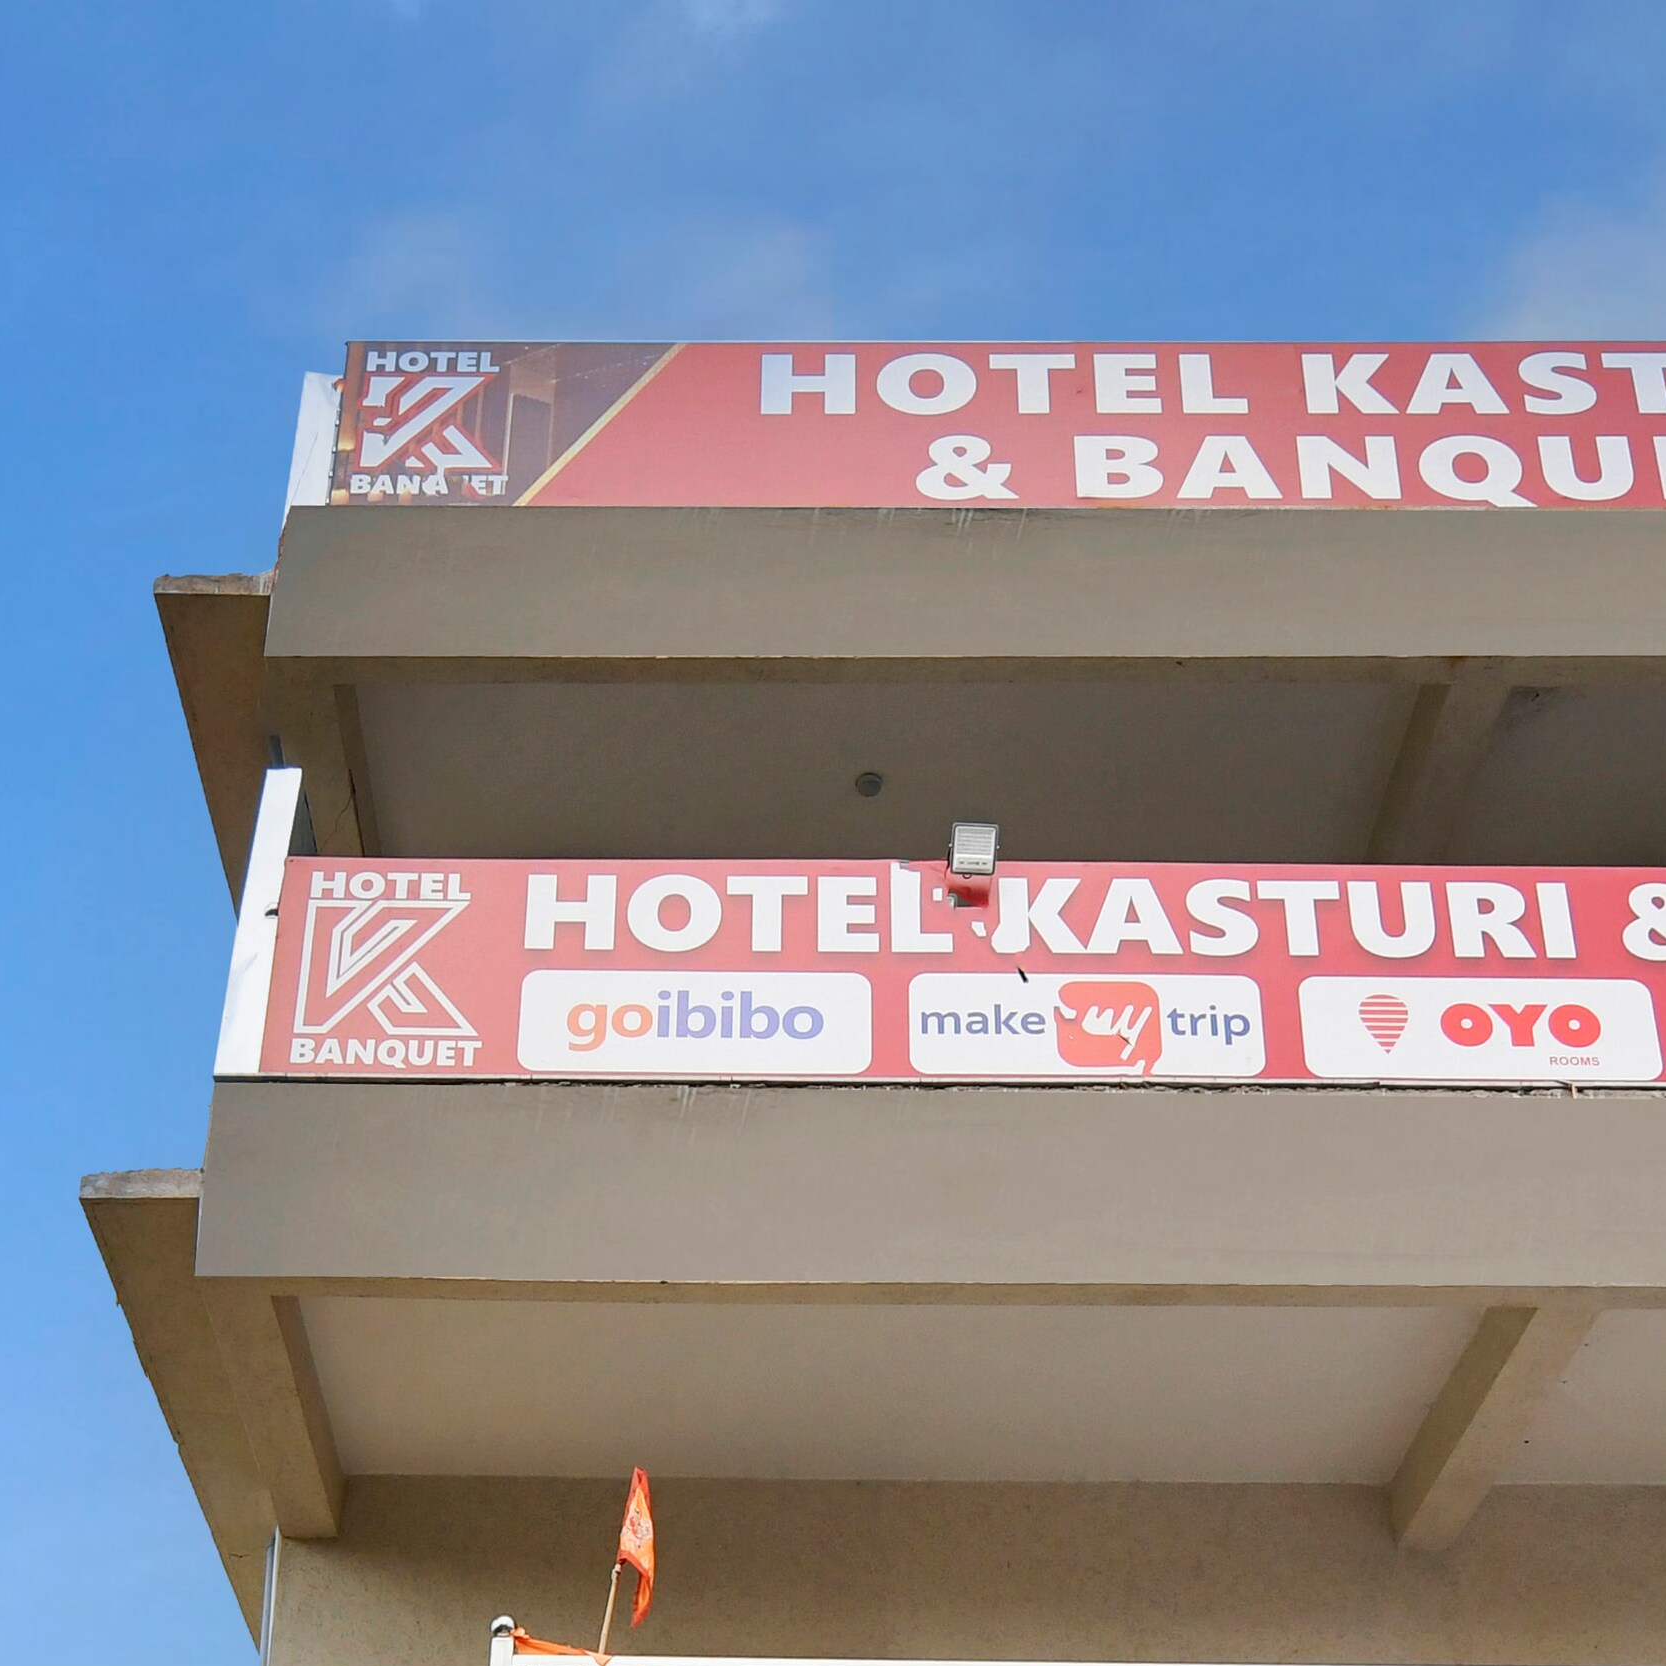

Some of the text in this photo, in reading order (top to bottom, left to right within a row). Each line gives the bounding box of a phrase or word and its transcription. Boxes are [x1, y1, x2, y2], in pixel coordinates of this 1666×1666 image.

[366, 351, 500, 373] HOTEL
[760, 352, 1249, 415] HOTEL
[915, 434, 1020, 500] &
[308, 870, 472, 900] HOTEL
[523, 868, 955, 954] HOTEL
[991, 876, 1578, 959] KASTURI
[565, 990, 825, 1052] goibibo
[920, 1003, 1047, 1036] make
[1166, 1004, 1251, 1046] trip
[1440, 1001, 1603, 1048] OYO
[288, 1037, 483, 1069] BANQUET
[1548, 1055, 1601, 1067] ROOMS
